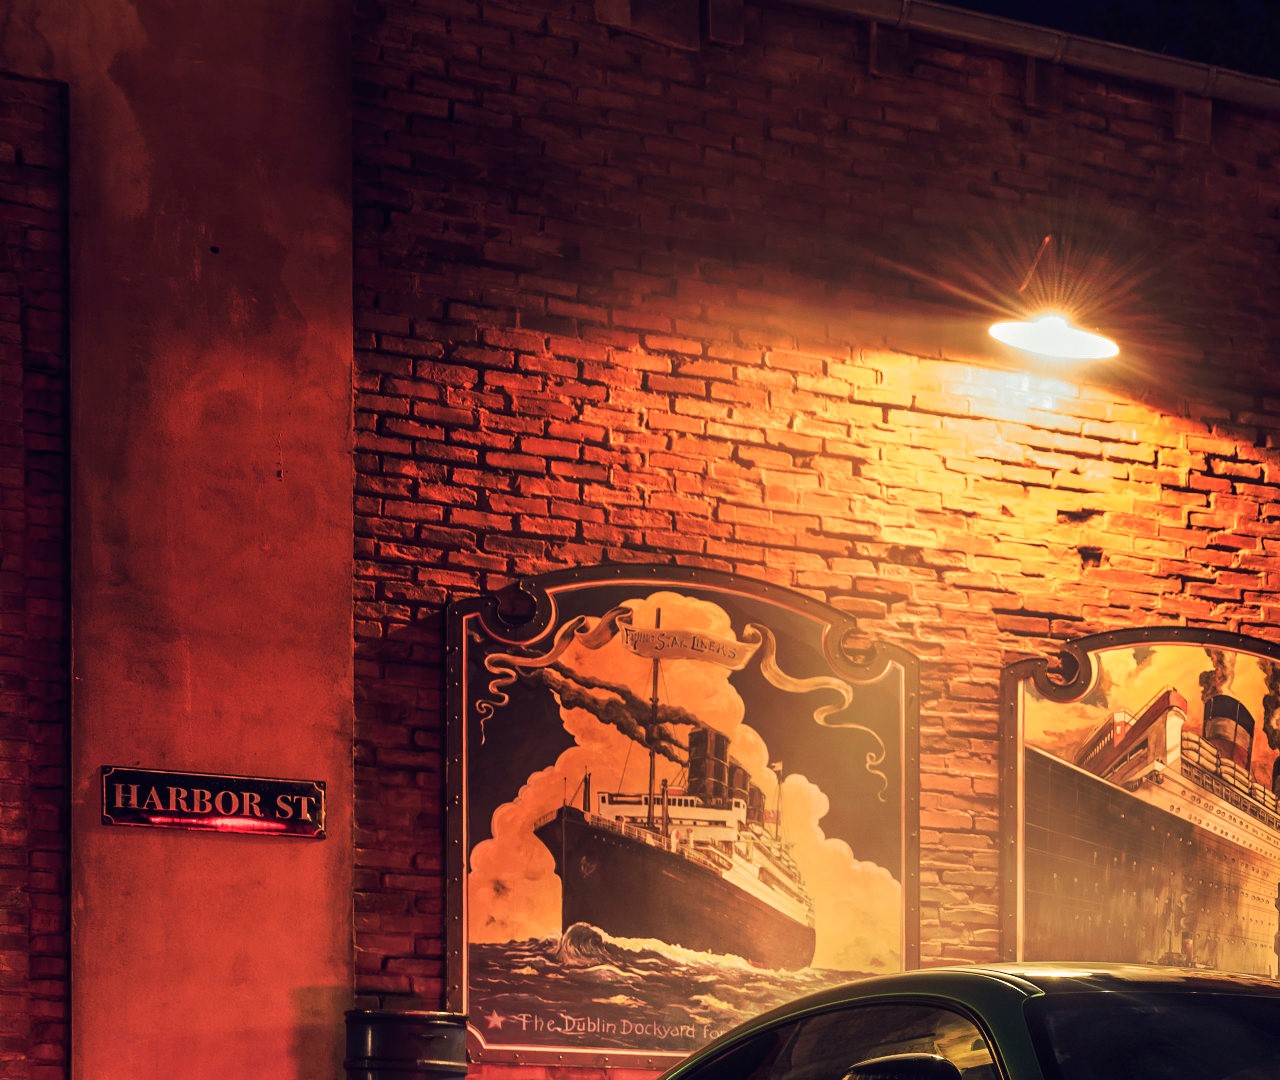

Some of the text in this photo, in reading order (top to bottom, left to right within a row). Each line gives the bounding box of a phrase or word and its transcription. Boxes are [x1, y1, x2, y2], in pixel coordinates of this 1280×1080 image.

[691, 636, 737, 659] LINERS
[112, 783, 316, 821] HARBOR ST
[513, 1013, 559, 1032] The
[559, 1012, 616, 1035] Dublin
[620, 1019, 695, 1039] Dockyard
